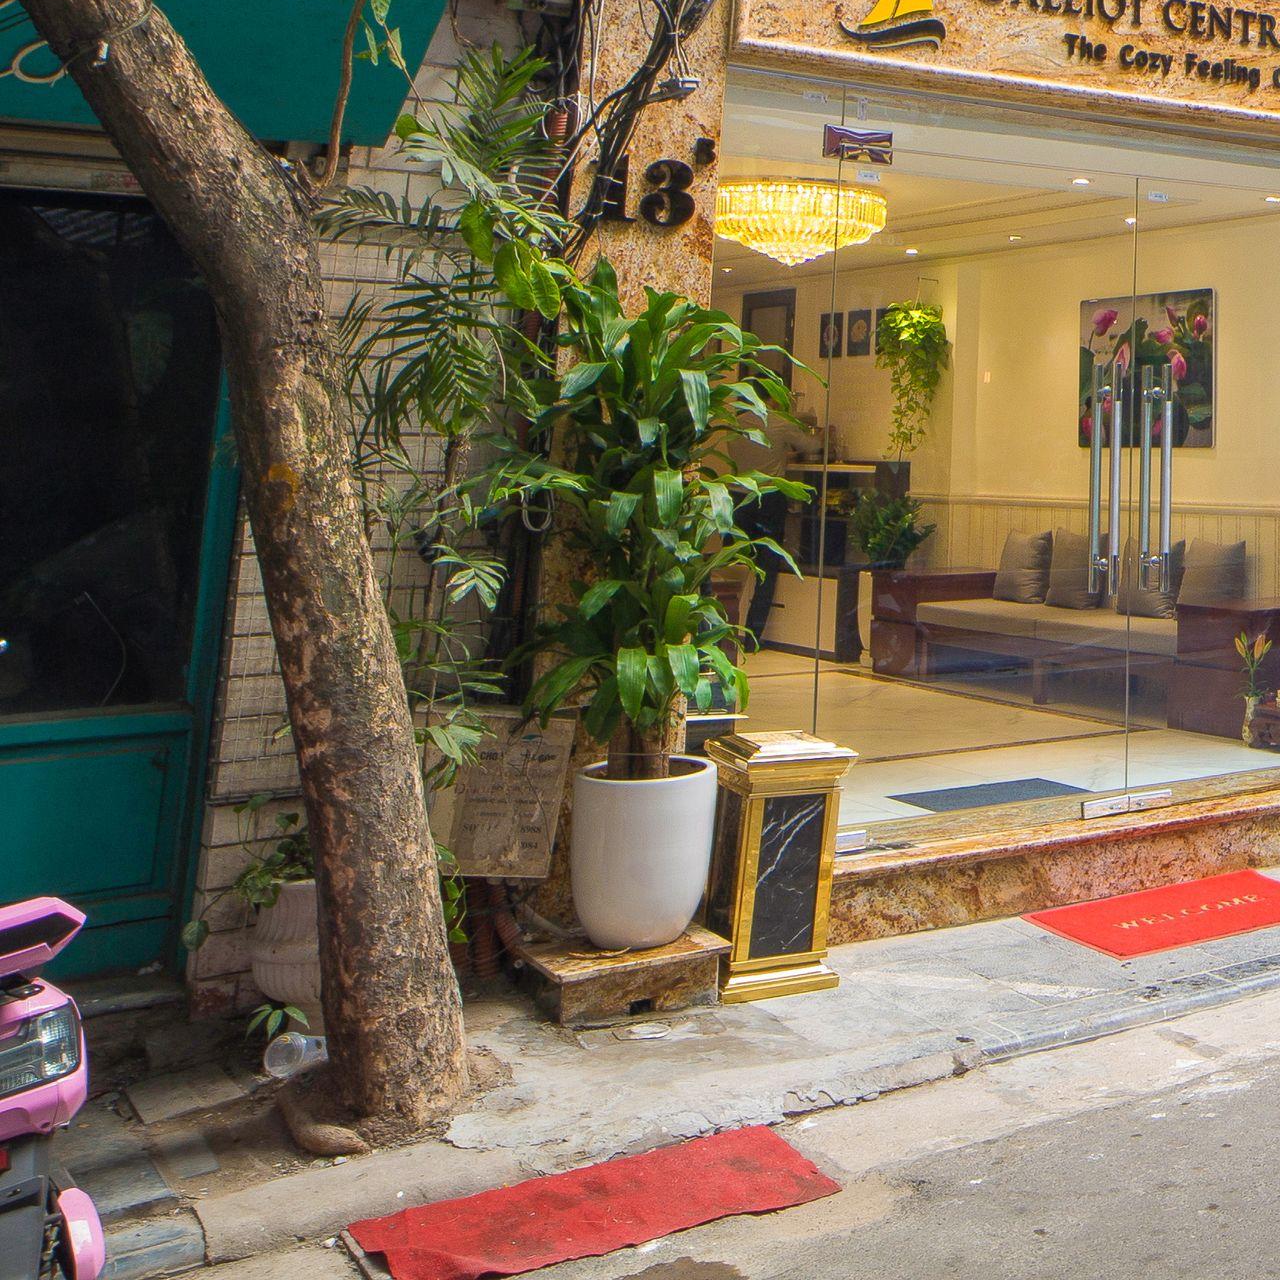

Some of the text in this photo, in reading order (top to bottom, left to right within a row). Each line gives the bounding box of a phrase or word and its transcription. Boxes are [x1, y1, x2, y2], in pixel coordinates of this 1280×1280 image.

[1064, 33, 1107, 62] The
[1120, 44, 1173, 77] Cozy
[1185, 52, 1261, 89] Feeling
[1112, 893, 1266, 931] WELCOME
